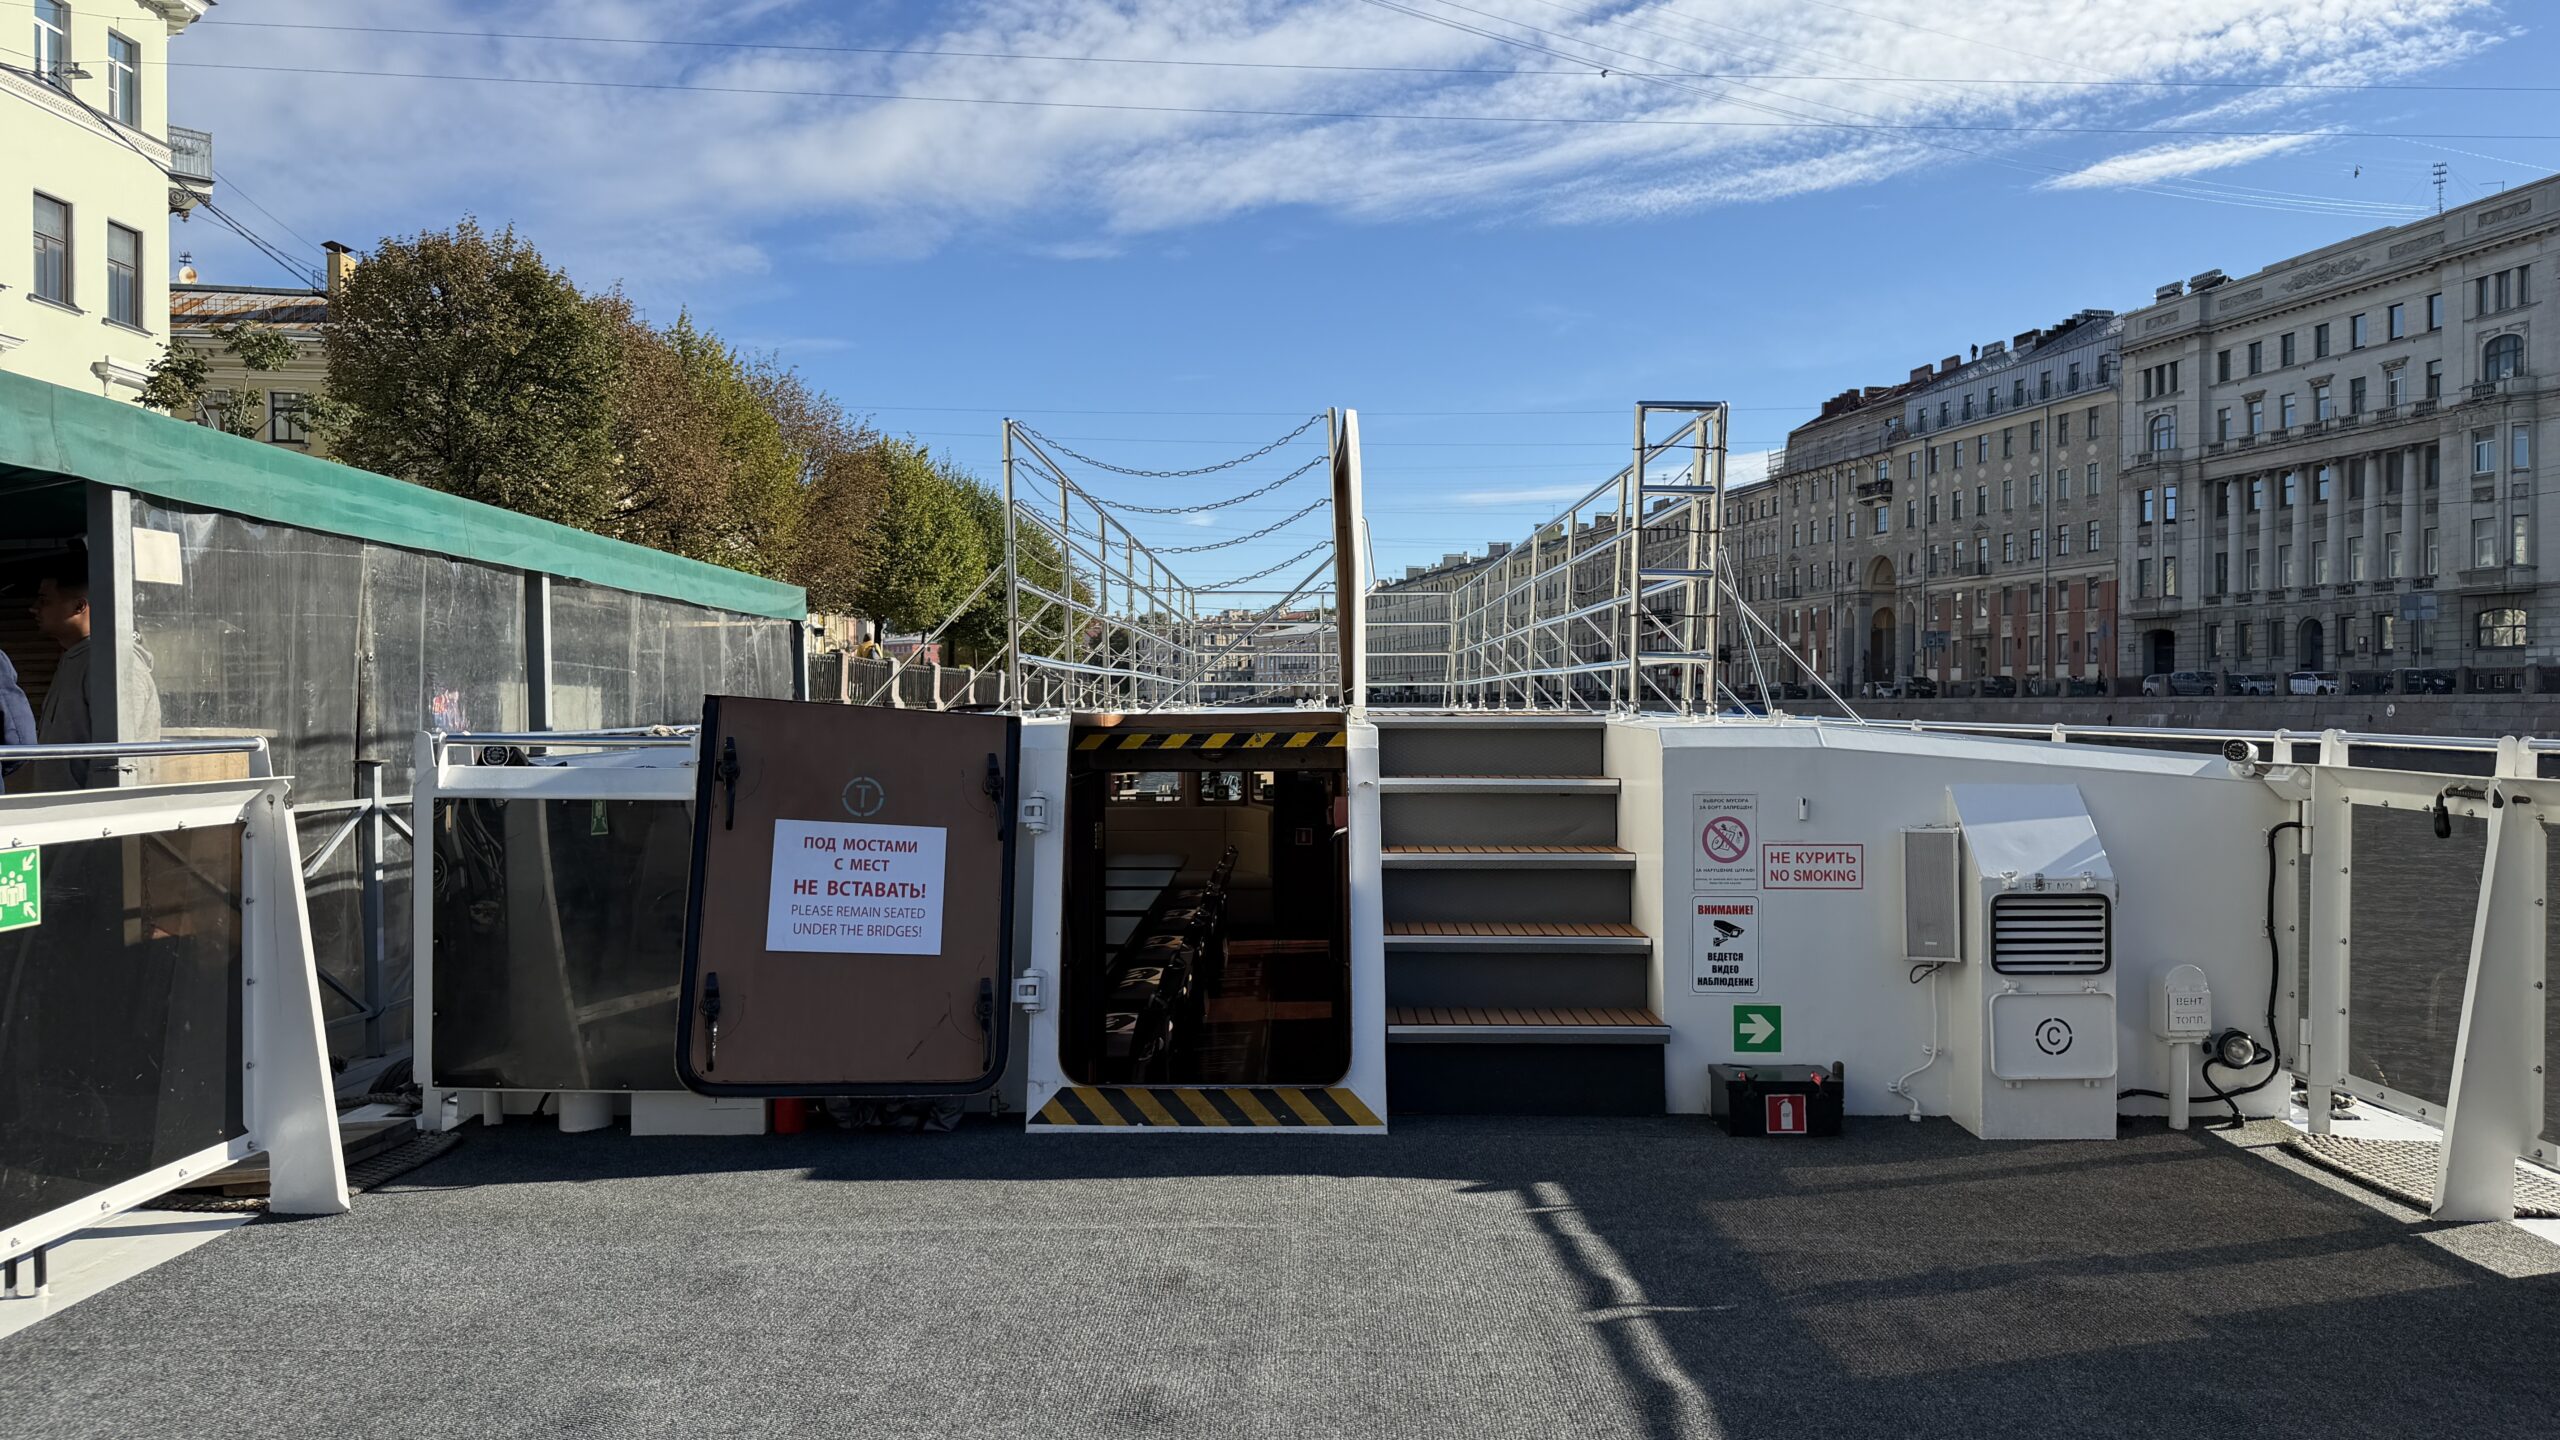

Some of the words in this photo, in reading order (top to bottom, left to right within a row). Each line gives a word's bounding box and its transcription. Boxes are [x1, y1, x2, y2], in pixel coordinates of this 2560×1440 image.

[804, 836, 836, 852] ПОД
[842, 838, 918, 853] МОСТАМИ
[1770, 851, 1790, 864] НЕ
[1795, 851, 1856, 864] КУРИТЬ
[834, 857, 843, 870] С
[849, 858, 890, 872] МЕСТ
[1770, 869, 1790, 882] NO
[1793, 869, 1856, 882] SMOKING
[793, 879, 818, 895] НЕ
[827, 880, 926, 899] ВСТАВАТЬ!
[791, 904, 833, 917] PLEASE
[836, 905, 881, 918] REMAIN
[884, 907, 926, 919] SEATED
[1697, 904, 1754, 915] ВНИМАНИЕ!
[793, 922, 837, 936] UNDER
[839, 924, 864, 937] THE
[867, 925, 922, 938] BRIDGES!
[1707, 952, 1744, 962] ВЕДЕТСЯ
[1711, 964, 1739, 975] ВИДЕО
[1697, 977, 1754, 987] НАБЛЮДЕНИЕ
